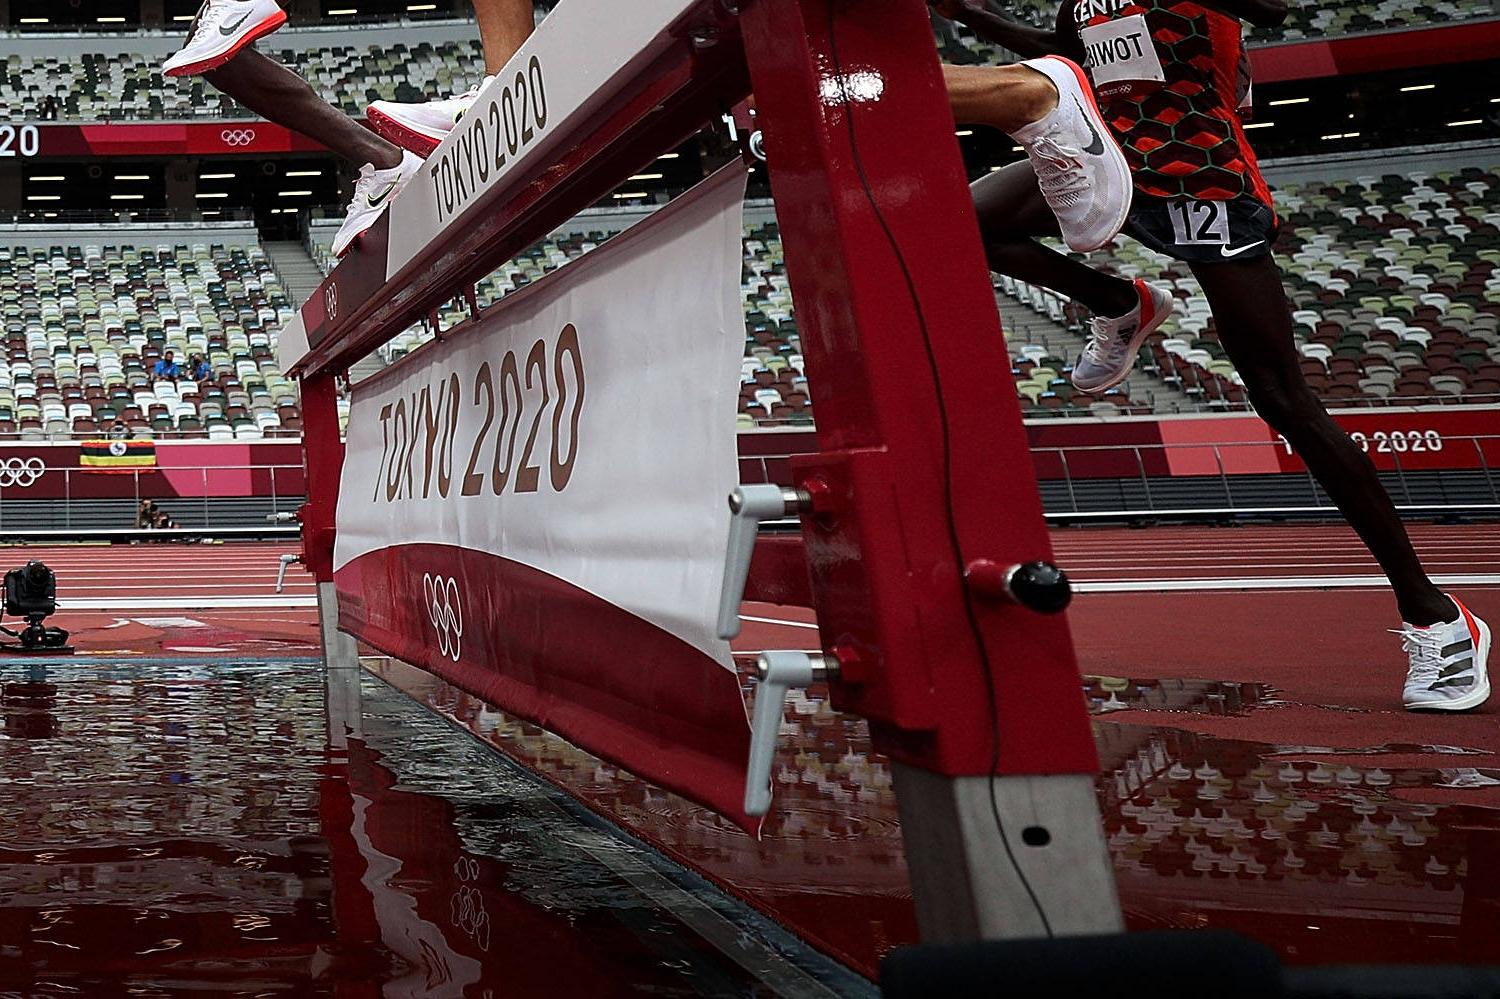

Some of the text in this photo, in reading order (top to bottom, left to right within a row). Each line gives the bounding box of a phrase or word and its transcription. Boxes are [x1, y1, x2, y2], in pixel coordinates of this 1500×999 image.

[431, 54, 548, 222] TOKYO 2020
[1173, 200, 1222, 241] 12
[373, 323, 585, 502] TOKYO 2020
[1373, 430, 1443, 452] 2020
